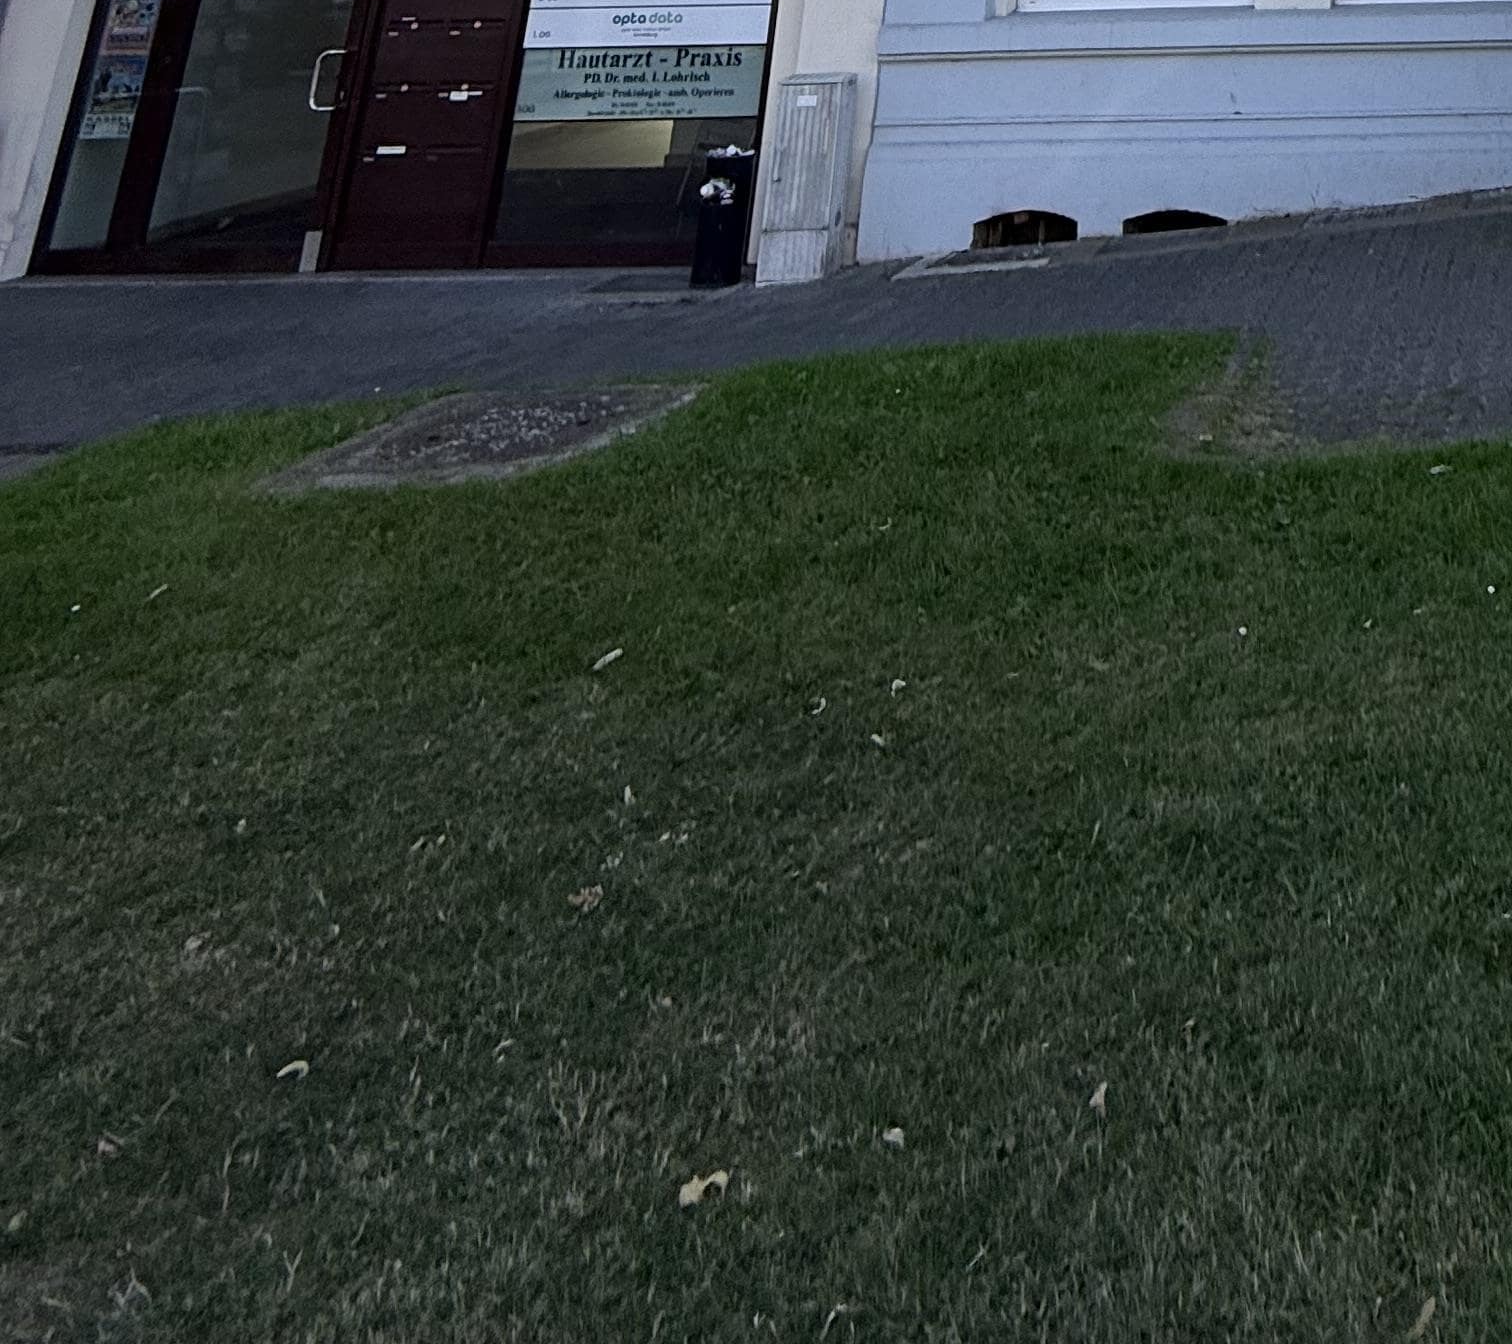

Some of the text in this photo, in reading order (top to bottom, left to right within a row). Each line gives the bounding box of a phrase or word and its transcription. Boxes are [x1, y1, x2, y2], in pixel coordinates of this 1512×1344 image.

[612, 11, 683, 26] opta data
[557, 49, 653, 69] Hautarzt
[673, 47, 743, 68] Praxis
[604, 72, 620, 83] Dr.
[622, 71, 646, 83] med.
[663, 70, 711, 82] Lohrisch
[553, 88, 604, 100] Allergologie
[691, 87, 735, 98] Operieren
